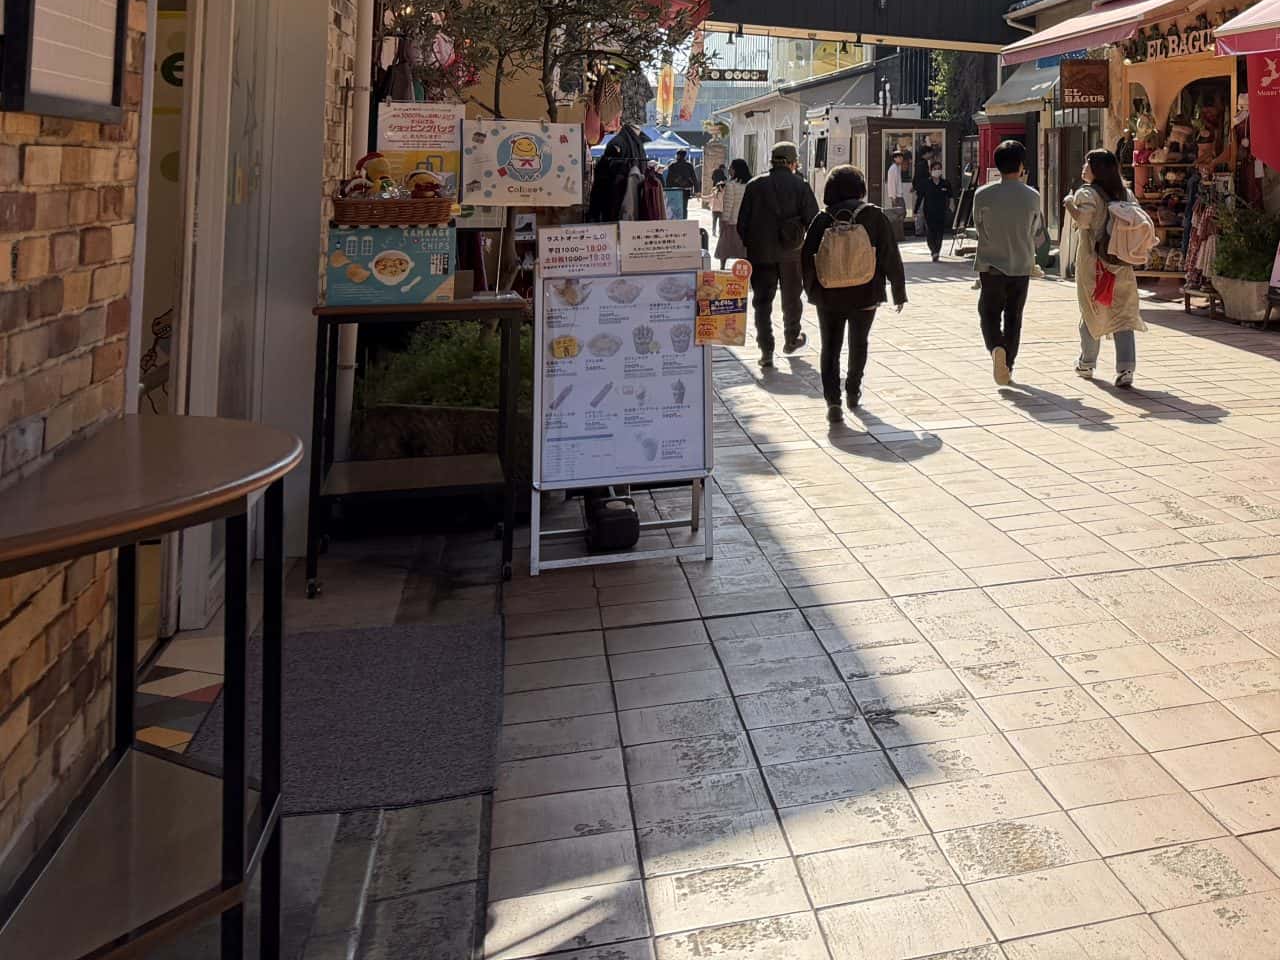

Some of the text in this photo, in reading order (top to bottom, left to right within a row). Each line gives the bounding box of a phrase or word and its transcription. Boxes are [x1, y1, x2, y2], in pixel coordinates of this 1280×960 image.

[1147, 27, 1213, 61] EL BAGU
[1063, 88, 1082, 96] EL
[1063, 95, 1105, 103] BAGUS
